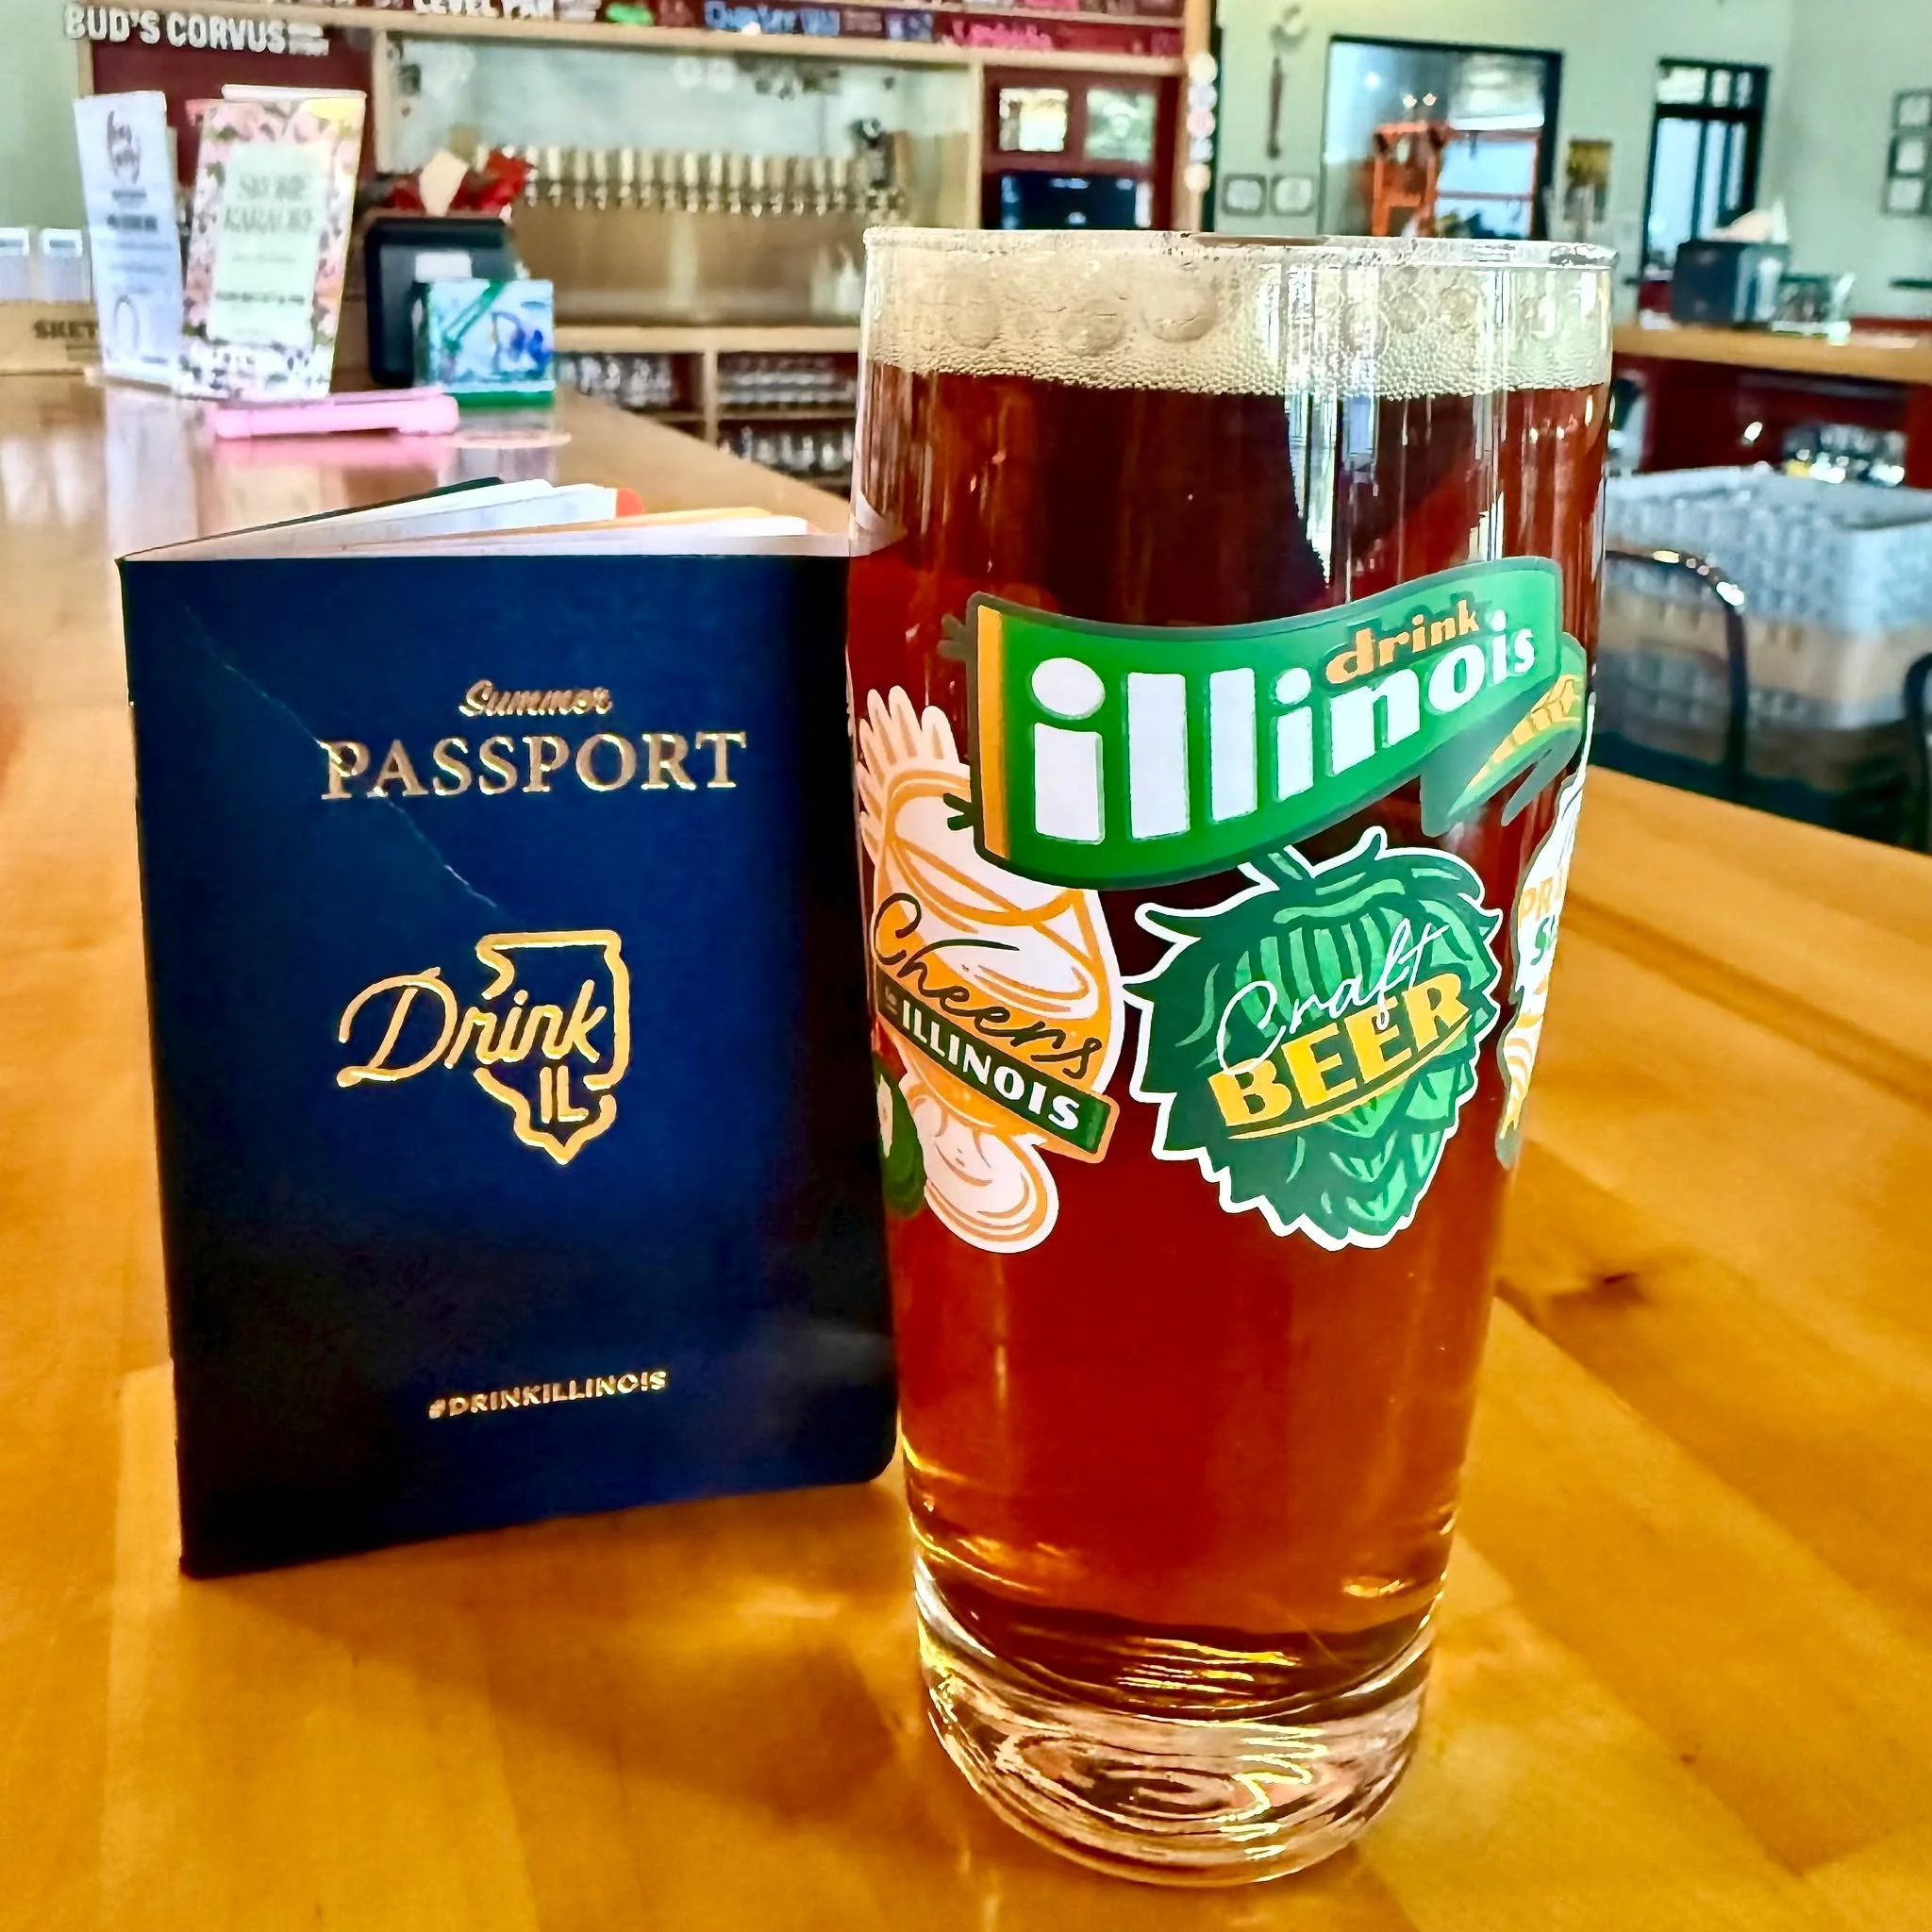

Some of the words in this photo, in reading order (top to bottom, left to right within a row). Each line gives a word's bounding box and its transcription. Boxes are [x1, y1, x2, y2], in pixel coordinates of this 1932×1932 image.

[63, 2, 160, 44] BUD'S
[166, 11, 286, 54] CORVUS
[1325, 599, 1480, 685] drink
[458, 679, 613, 717] Summer
[1030, 609, 1536, 845] illinois
[320, 730, 747, 800] PASSPORT
[336, 966, 608, 1088] Drink
[874, 891, 1103, 1079] Cheers
[1216, 917, 1450, 1075] Craft
[539, 1065, 590, 1124] IL
[902, 999, 1080, 1131] ILLINOIS
[1208, 972, 1470, 1127] BEER
[428, 1371, 667, 1420] #DRINKILLINOIS
